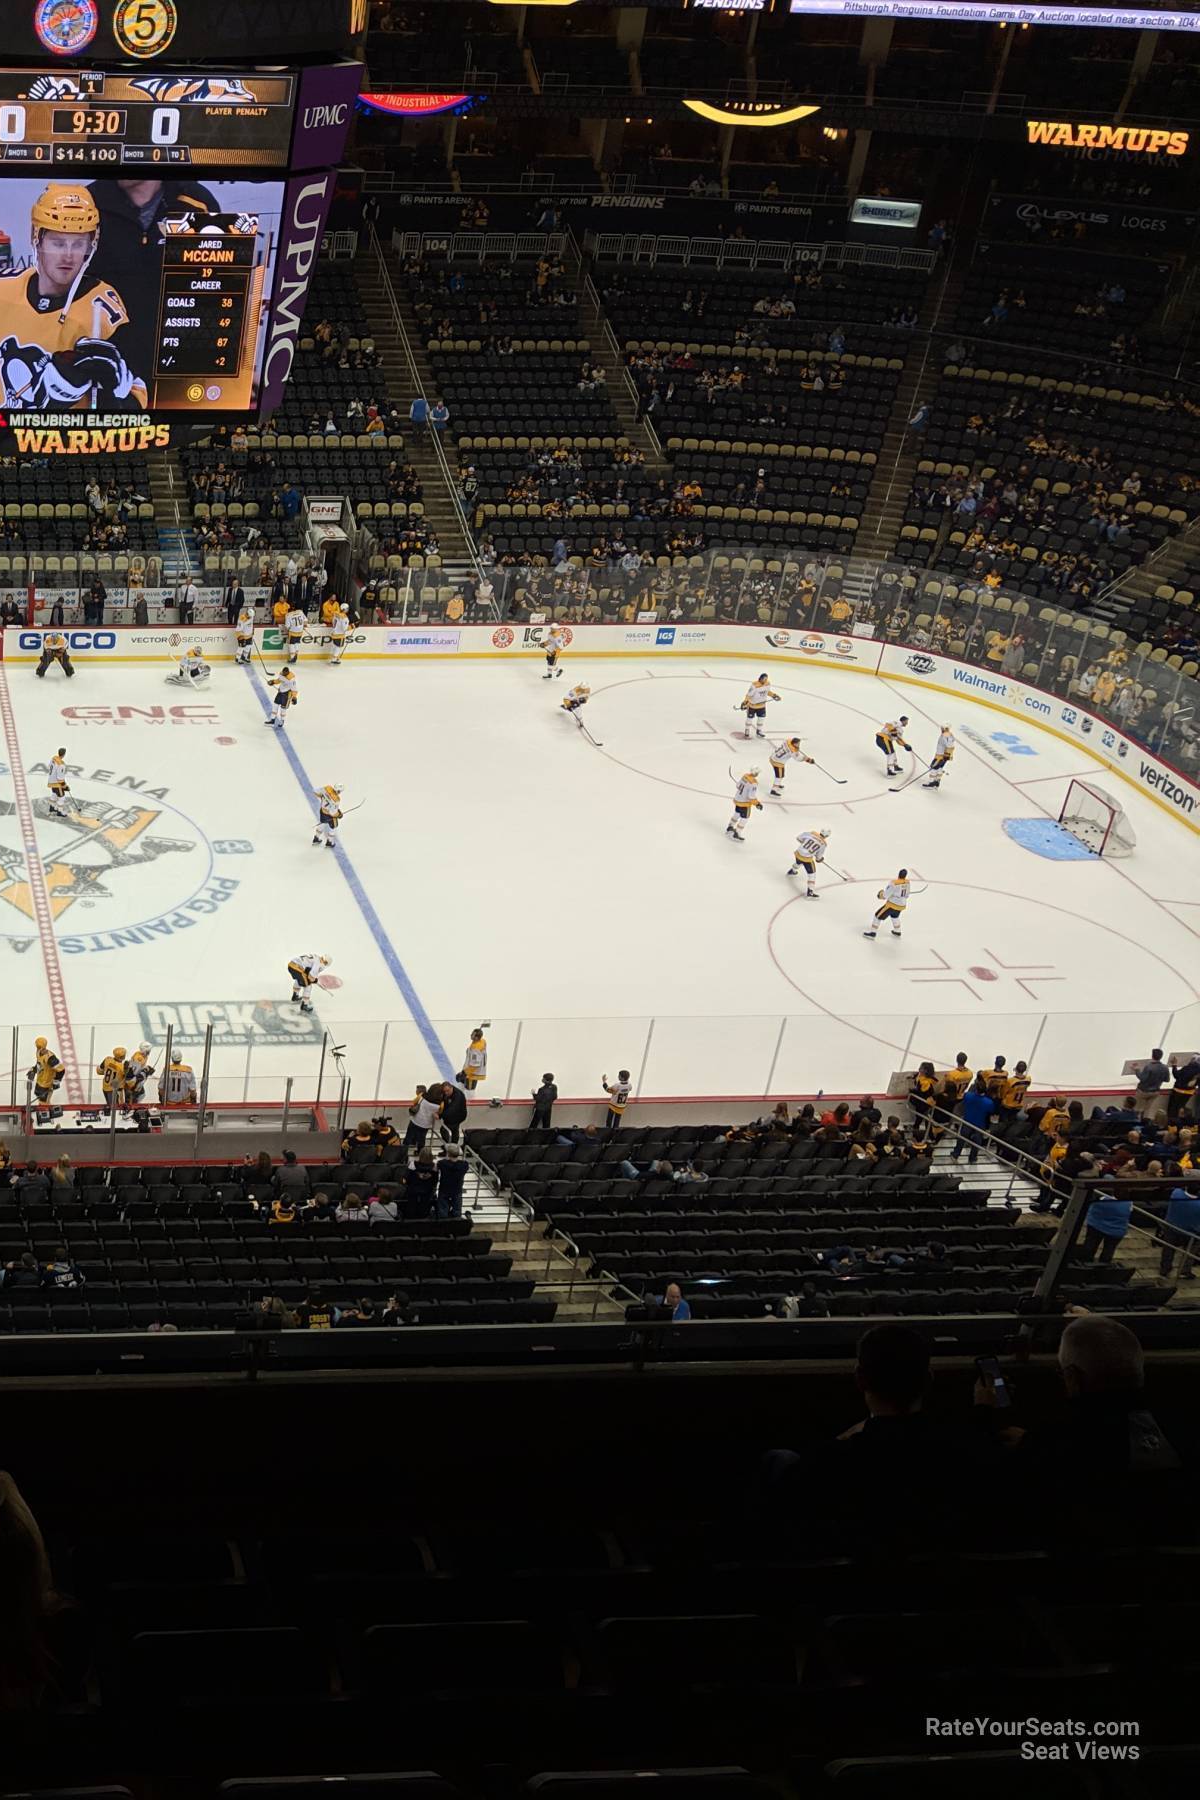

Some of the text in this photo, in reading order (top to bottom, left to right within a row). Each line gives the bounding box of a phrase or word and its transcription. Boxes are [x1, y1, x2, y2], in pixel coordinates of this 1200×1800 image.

[843, 2, 889, 14] Pittsburgh
[892, 4, 933, 16] Penguins
[936, 6, 987, 18] Foundation
[989, 8, 1016, 19] Game
[1018, 10, 1036, 21] Day
[1038, 11, 1075, 22] Auction
[1077, 13, 1112, 24] located
[1115, 16, 1137, 25] near
[1140, 16, 1175, 26] section
[134, 4, 157, 40] 5
[81, 73, 103, 81] PERIOD
[87, 81, 96, 93] 1
[206, 107, 268, 116] PLAYER PENALTY
[303, 103, 348, 129] UPMC
[72, 111, 120, 133] 9:30
[152, 108, 180, 144] 0
[1026, 120, 1190, 156] WARMUPS
[35, 147, 43, 160] 0
[153, 149, 160, 161] 0
[591, 195, 666, 209] PENGUINS
[750, 204, 781, 215] PAINTS
[782, 206, 813, 217] ARENA
[1041, 208, 1168, 232] LEXUS LOGES
[198, 240, 222, 249] JARED
[425, 239, 448, 250] 104
[183, 250, 234, 262] MCCANN
[795, 250, 819, 261] 104
[202, 268, 213, 278] 19
[190, 281, 221, 290] CAREER
[264, 175, 328, 388] UPMC
[167, 298, 233, 308] GOALS 38
[165, 318, 231, 327] ASSISTS 49
[163, 337, 229, 347] PTS 87
[9, 413, 151, 427] MITSUBISHI ELECTRIC
[13, 424, 170, 454] WARMUPS
[311, 506, 340, 514] GNC
[131, 635, 228, 644] VECTOR SECURITY
[523, 627, 543, 642] IC
[658, 631, 673, 640] IGS
[400, 638, 433, 646] BAIERL
[799, 639, 825, 651] Gulf
[905, 655, 936, 670] NHL
[953, 668, 1051, 715] Walmart com
[60, 705, 219, 719] GNC
[1139, 760, 1195, 813] verizon
[104, 1068, 117, 1083] 81
